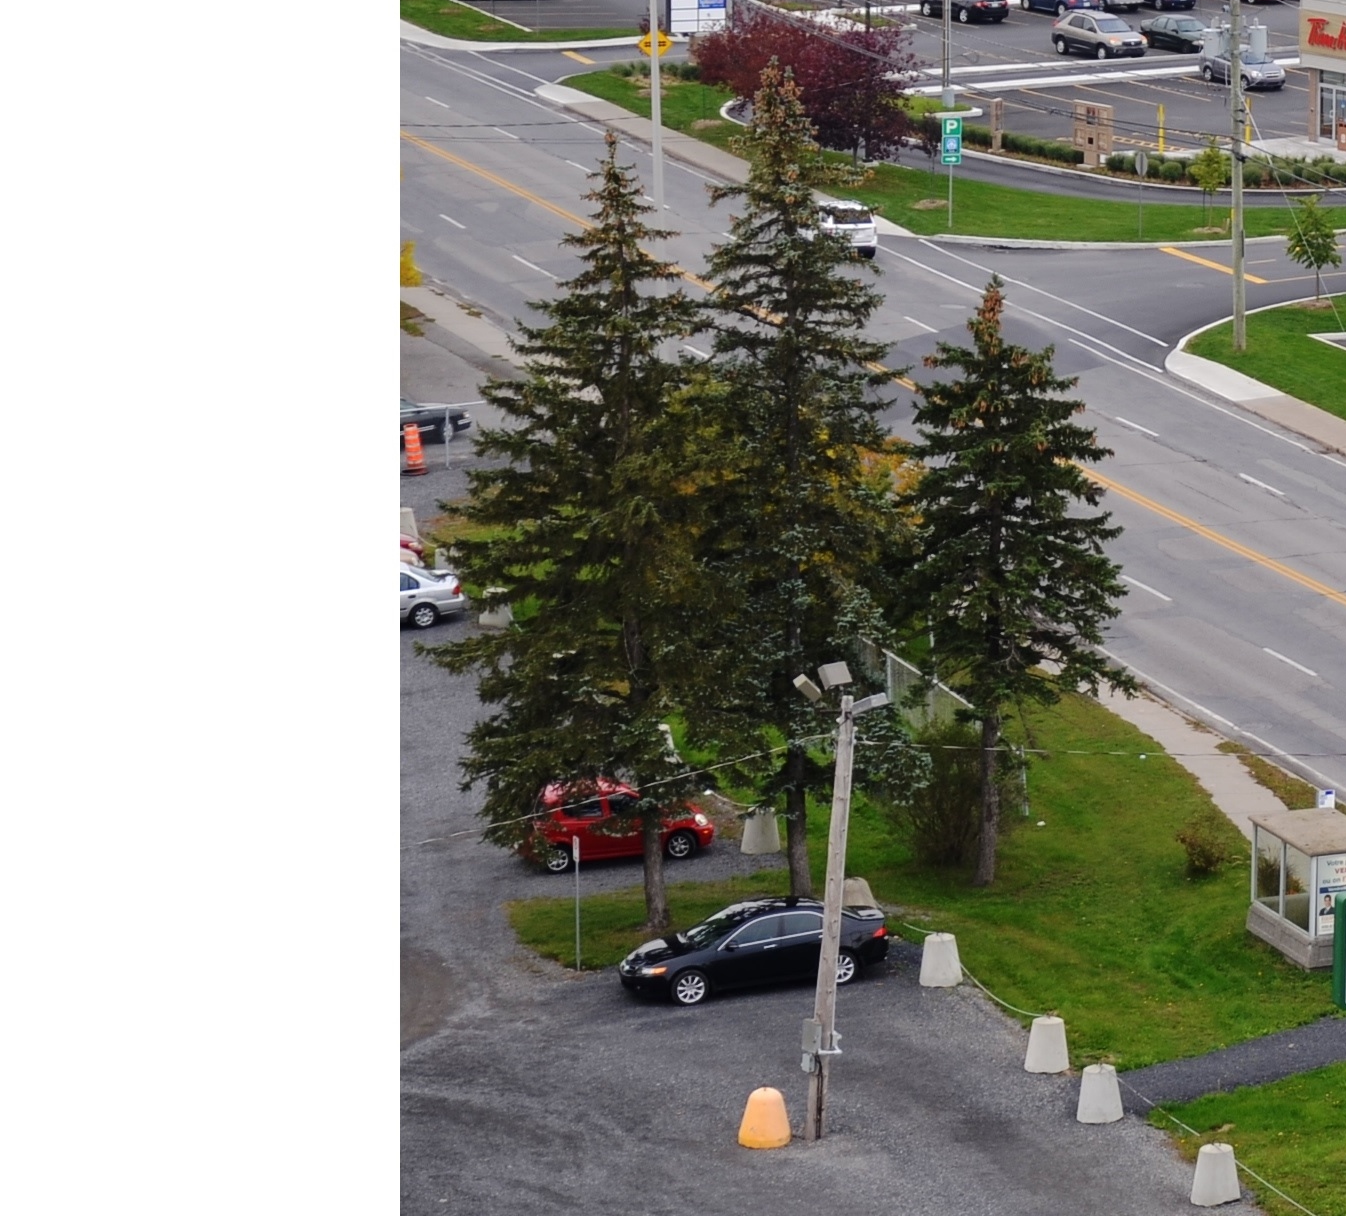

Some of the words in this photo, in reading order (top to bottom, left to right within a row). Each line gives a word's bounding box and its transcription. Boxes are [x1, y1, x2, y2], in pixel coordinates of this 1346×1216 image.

[1307, 17, 1337, 50] Tim
[945, 119, 958, 134] P
[1326, 858, 1344, 866] Votre
